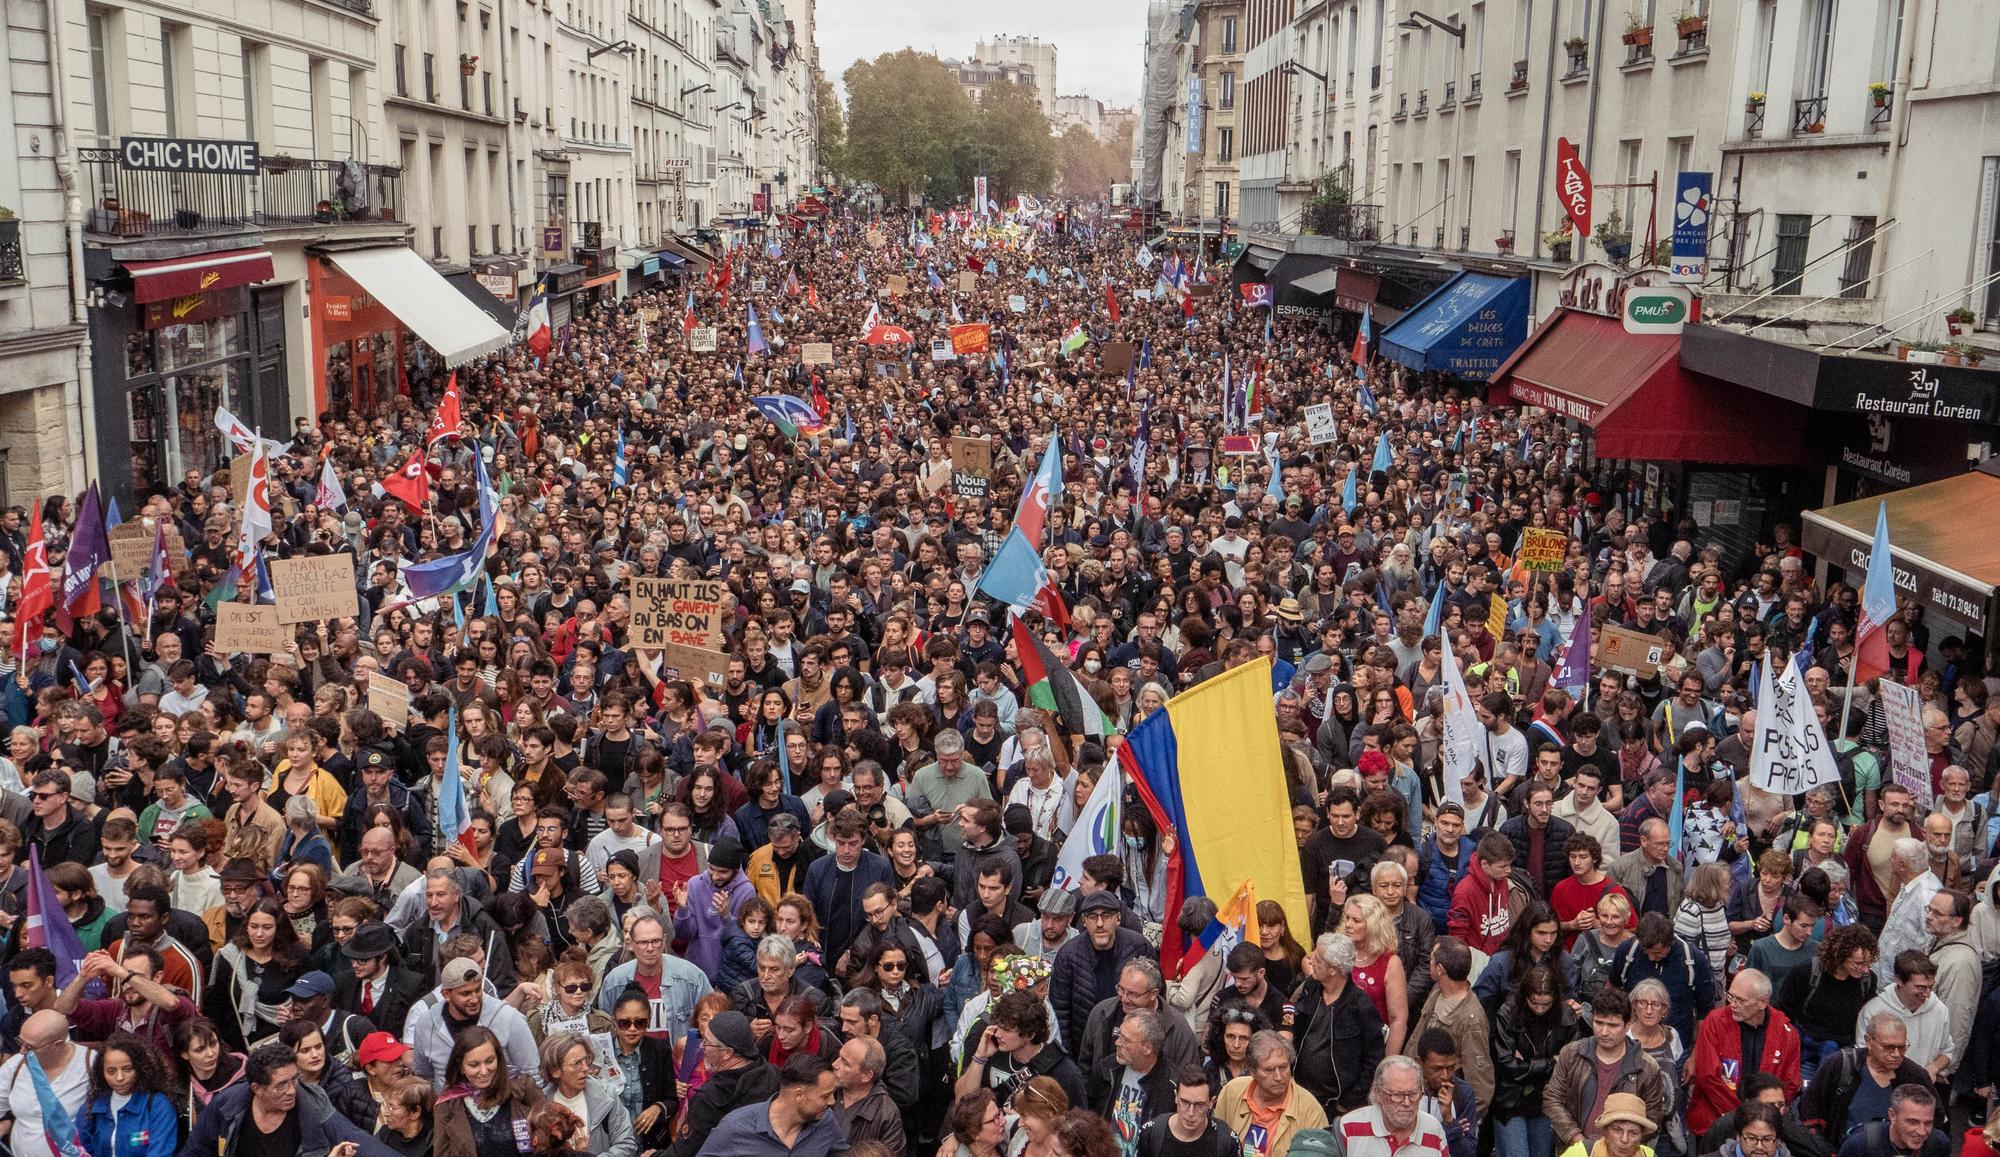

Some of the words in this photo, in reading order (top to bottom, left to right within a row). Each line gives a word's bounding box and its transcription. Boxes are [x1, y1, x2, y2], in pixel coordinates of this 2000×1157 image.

[126, 141, 182, 168] CHIC
[187, 144, 255, 171] HOME
[1562, 158, 1587, 216] TABAC
[1276, 304, 1320, 317] ESPACE
[1480, 310, 1496, 320] LES
[1634, 305, 1661, 316] PMU
[1460, 337, 1473, 346] DE
[1450, 357, 1499, 368] TRAITEUR
[1909, 368, 1940, 398] 진미
[1543, 391, 1557, 408] L'AS
[1557, 396, 1566, 412] DE
[1855, 393, 1930, 416] Restaurant
[1933, 400, 1981, 421] Coréen
[1842, 447, 1882, 474] Restaurant
[1883, 460, 1911, 483] Coréen
[955, 473, 987, 487] Nous
[957, 485, 985, 497] tous
[290, 560, 326, 572] MANU
[324, 568, 348, 581] GAZ
[636, 582, 653, 598] EN
[657, 583, 690, 600] HAUT
[694, 585, 720, 603] ILS
[649, 597, 668, 613] SE
[672, 600, 719, 615] GAVENT
[1972, 604, 1979, 620] 21
[230, 612, 242, 623] ON
[245, 612, 263, 623] EST
[634, 613, 650, 627] EN
[656, 614, 683, 629] BAS
[685, 615, 709, 631] ON
[643, 628, 664, 644] EN
[670, 631, 710, 646] BAVE
